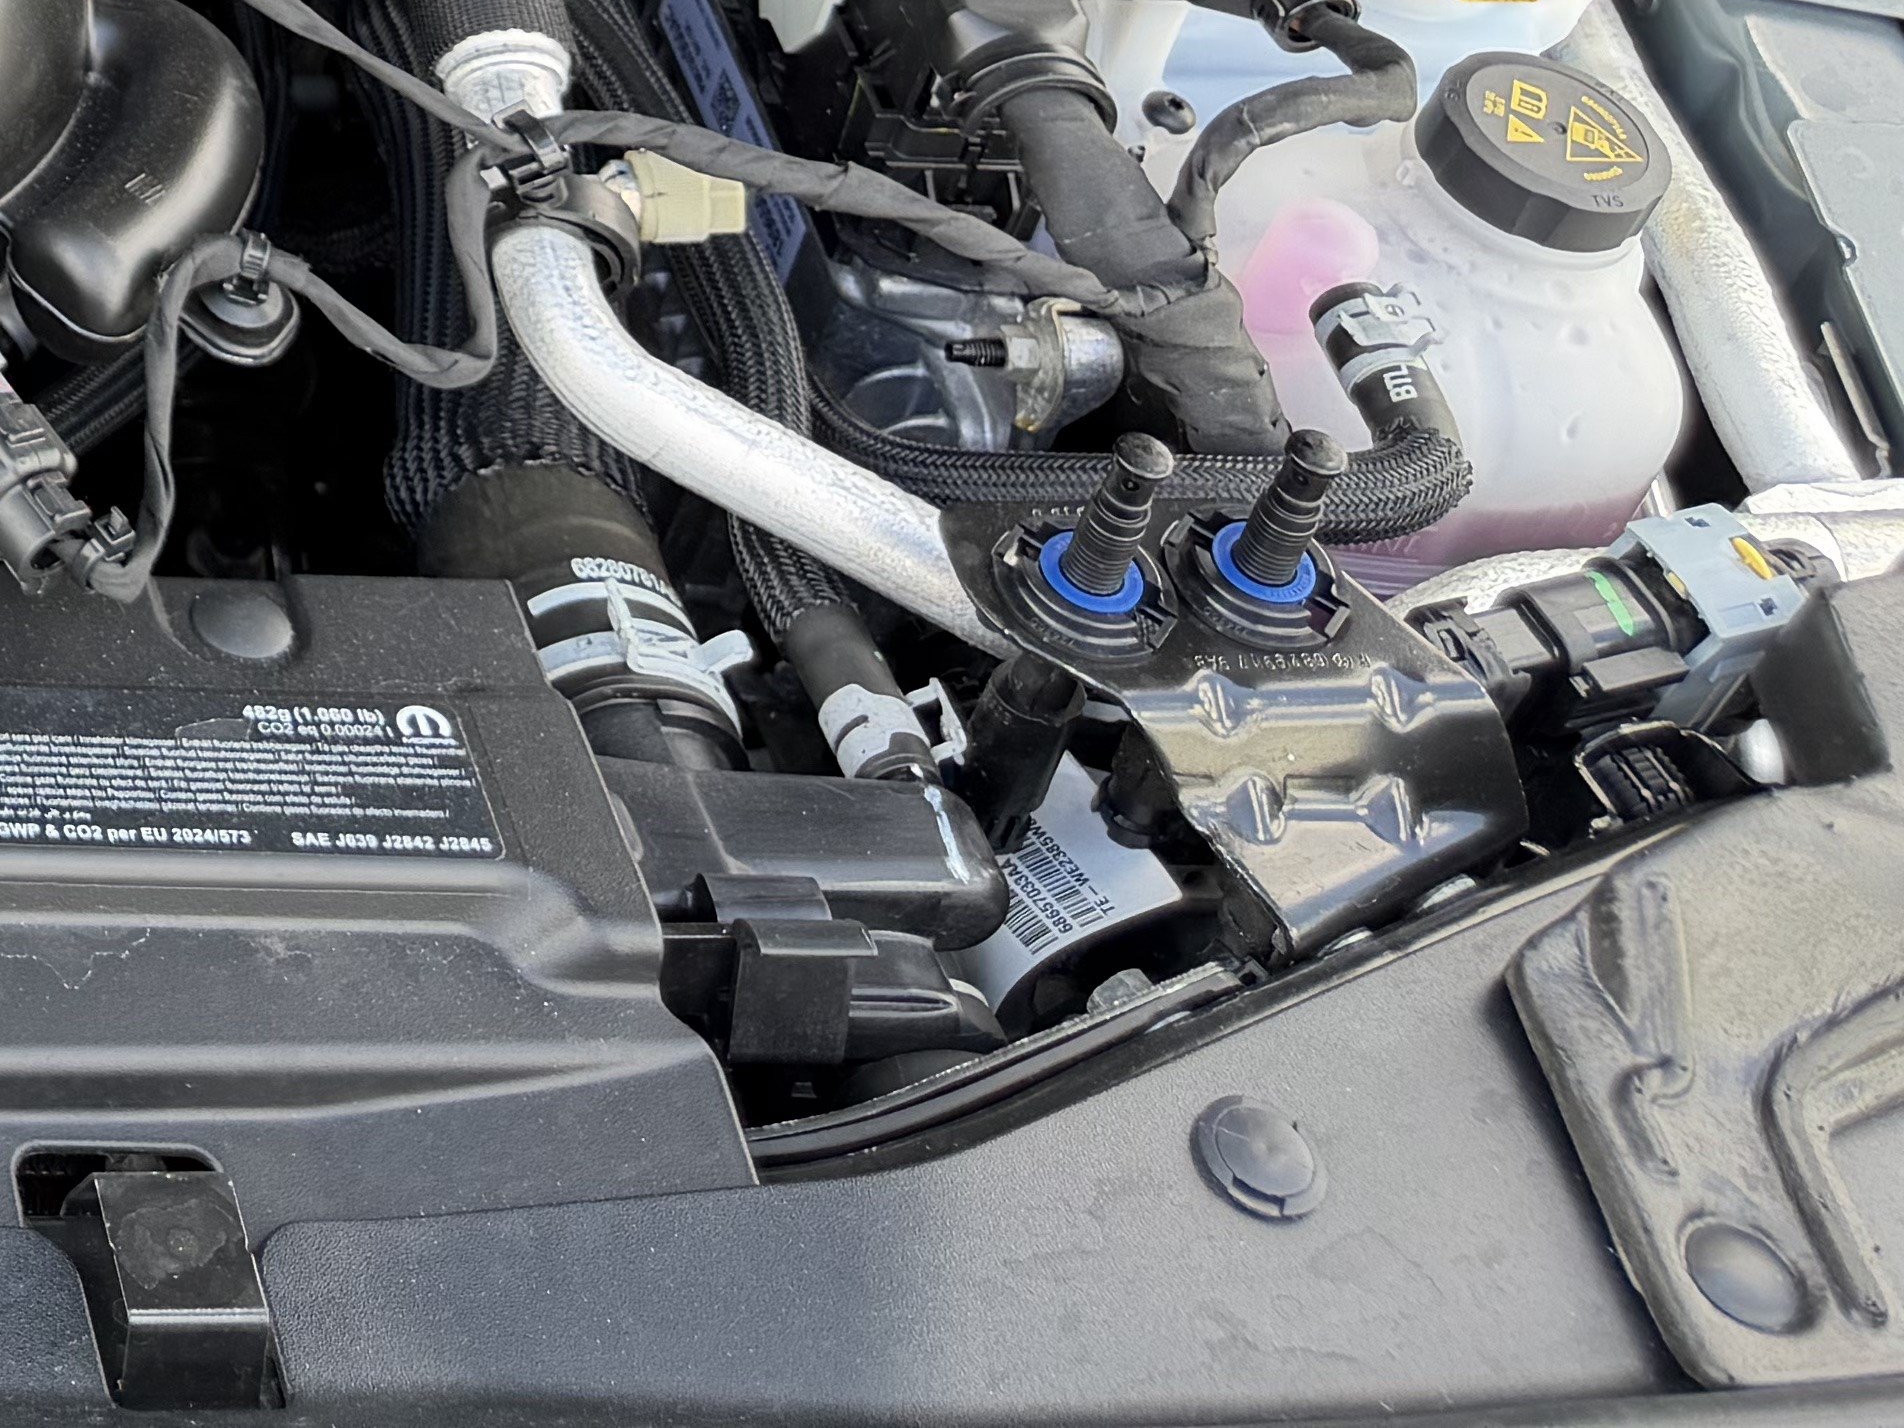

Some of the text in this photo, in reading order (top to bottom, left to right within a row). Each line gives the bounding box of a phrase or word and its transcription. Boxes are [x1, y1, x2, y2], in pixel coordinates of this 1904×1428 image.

[357, 708, 385, 726] lb)
[257, 721, 294, 734] CO2
[297, 724, 319, 738] eq
[321, 723, 383, 738] 0.00024
[45, 824, 60, 840] &
[63, 824, 103, 841] CO2
[106, 828, 137, 844] per
[141, 826, 168, 842] EU
[172, 828, 252, 844] 2024/573
[292, 831, 331, 846] SAE
[1000, 858, 1073, 933] 68657033AA
[1094, 896, 1115, 916] TE
